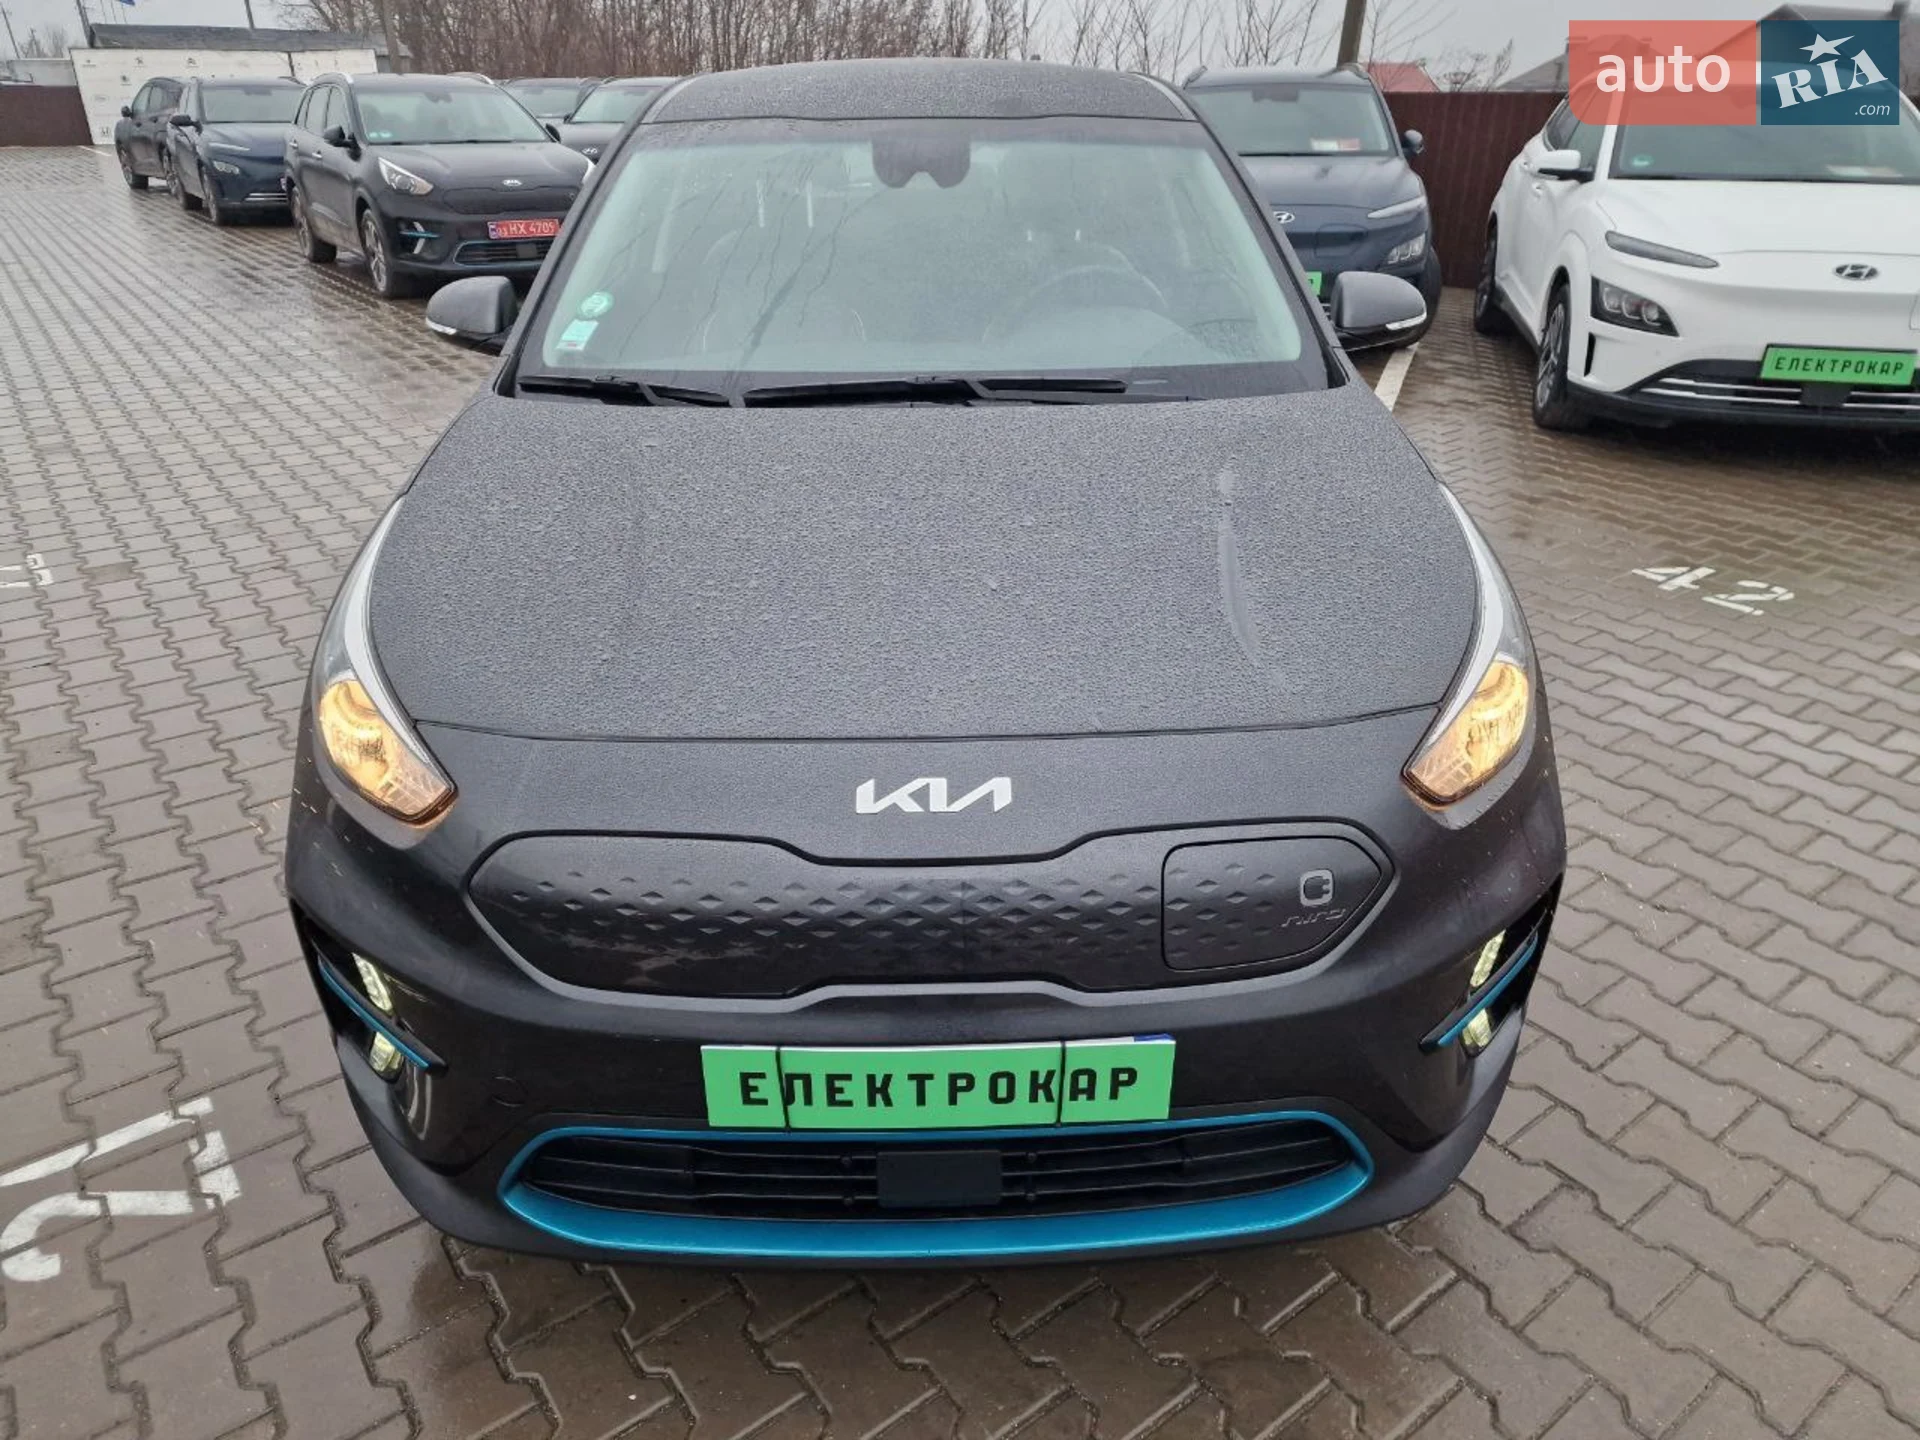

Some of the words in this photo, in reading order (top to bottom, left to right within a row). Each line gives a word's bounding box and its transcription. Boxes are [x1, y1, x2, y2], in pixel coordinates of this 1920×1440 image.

[1774, 356, 1905, 376] ЕЛЕКТРОКАР
[1631, 566, 1796, 616] 42
[855, 776, 1013, 814] KIA
[739, 1066, 1139, 1108] ЕЛЕКТРОКАР
